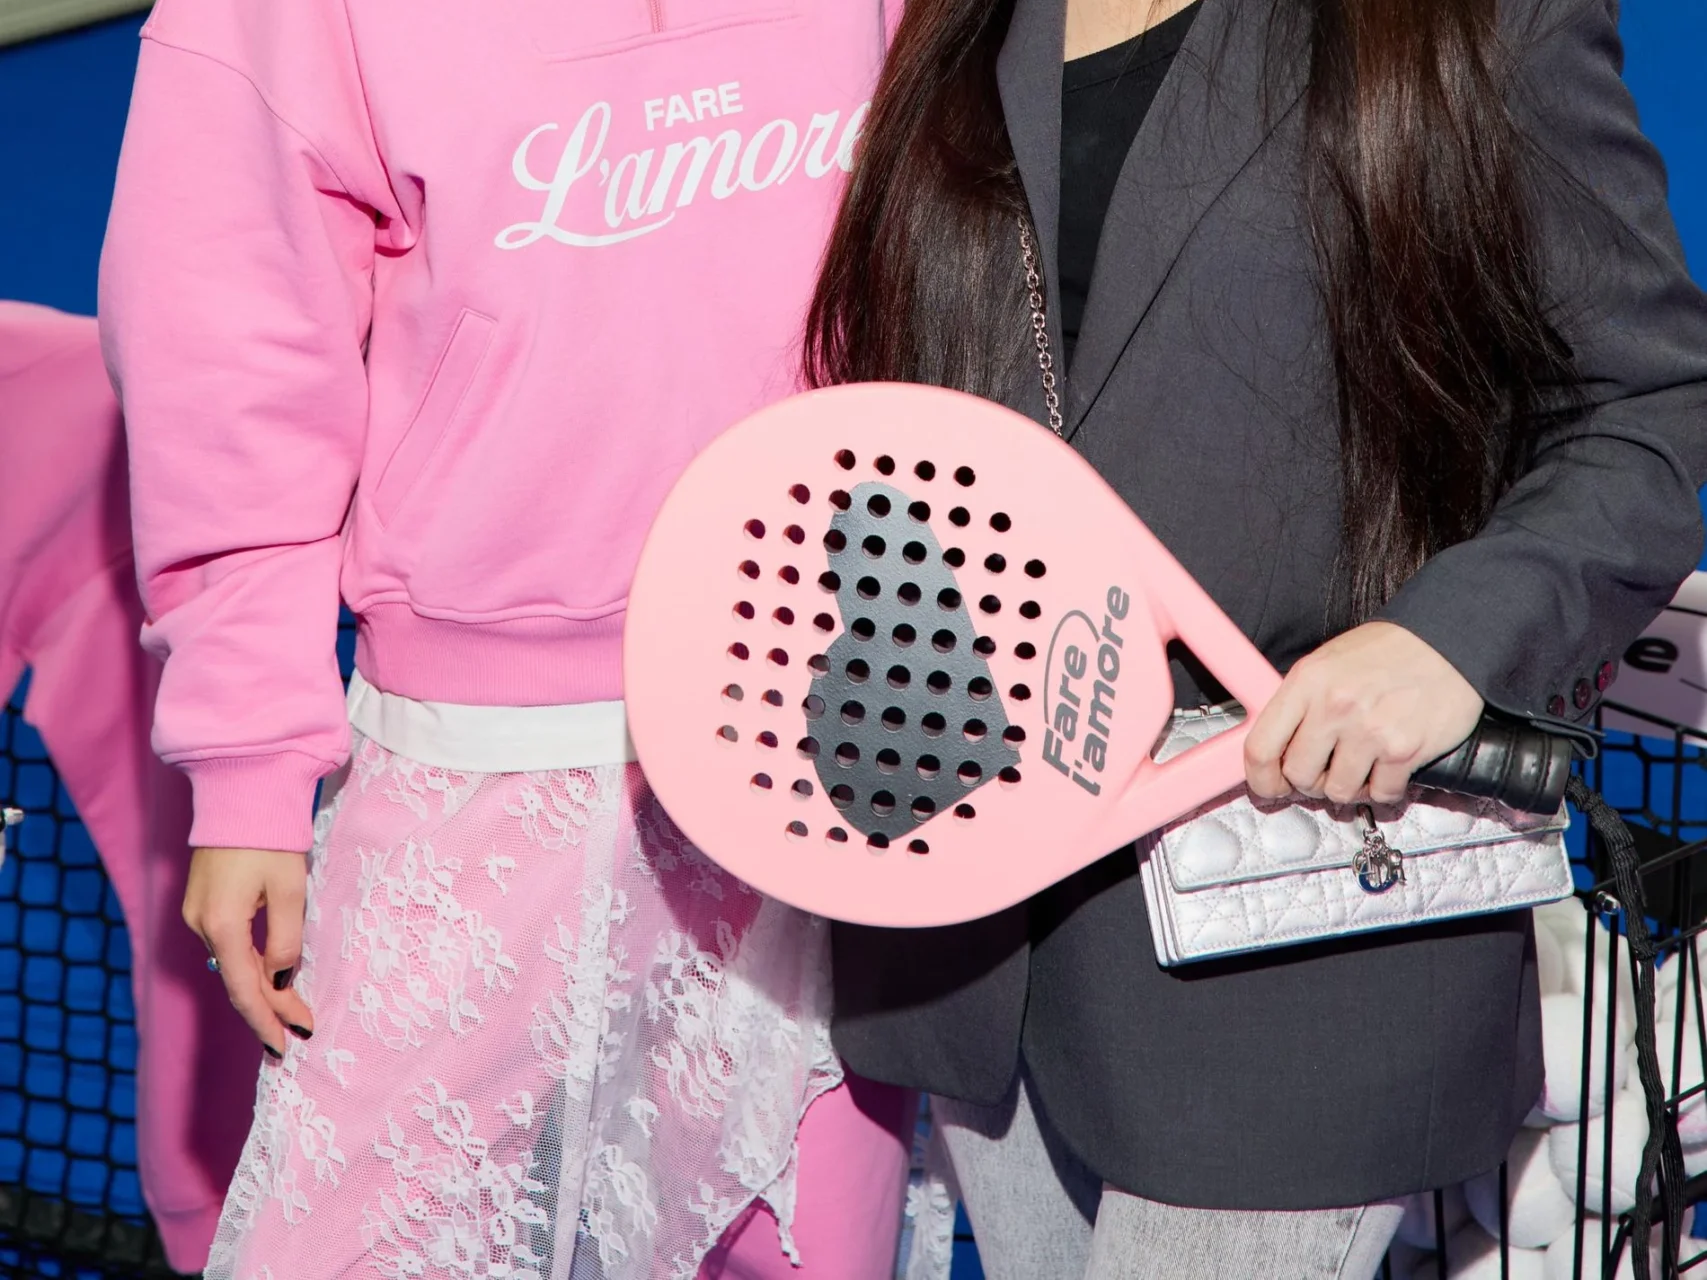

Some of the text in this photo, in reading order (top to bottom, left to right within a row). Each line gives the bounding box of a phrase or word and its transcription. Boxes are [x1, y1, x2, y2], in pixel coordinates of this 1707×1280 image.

[644, 82, 744, 131] FARE
[1042, 644, 1088, 777] Fare
[1069, 586, 1130, 796] l'amore
